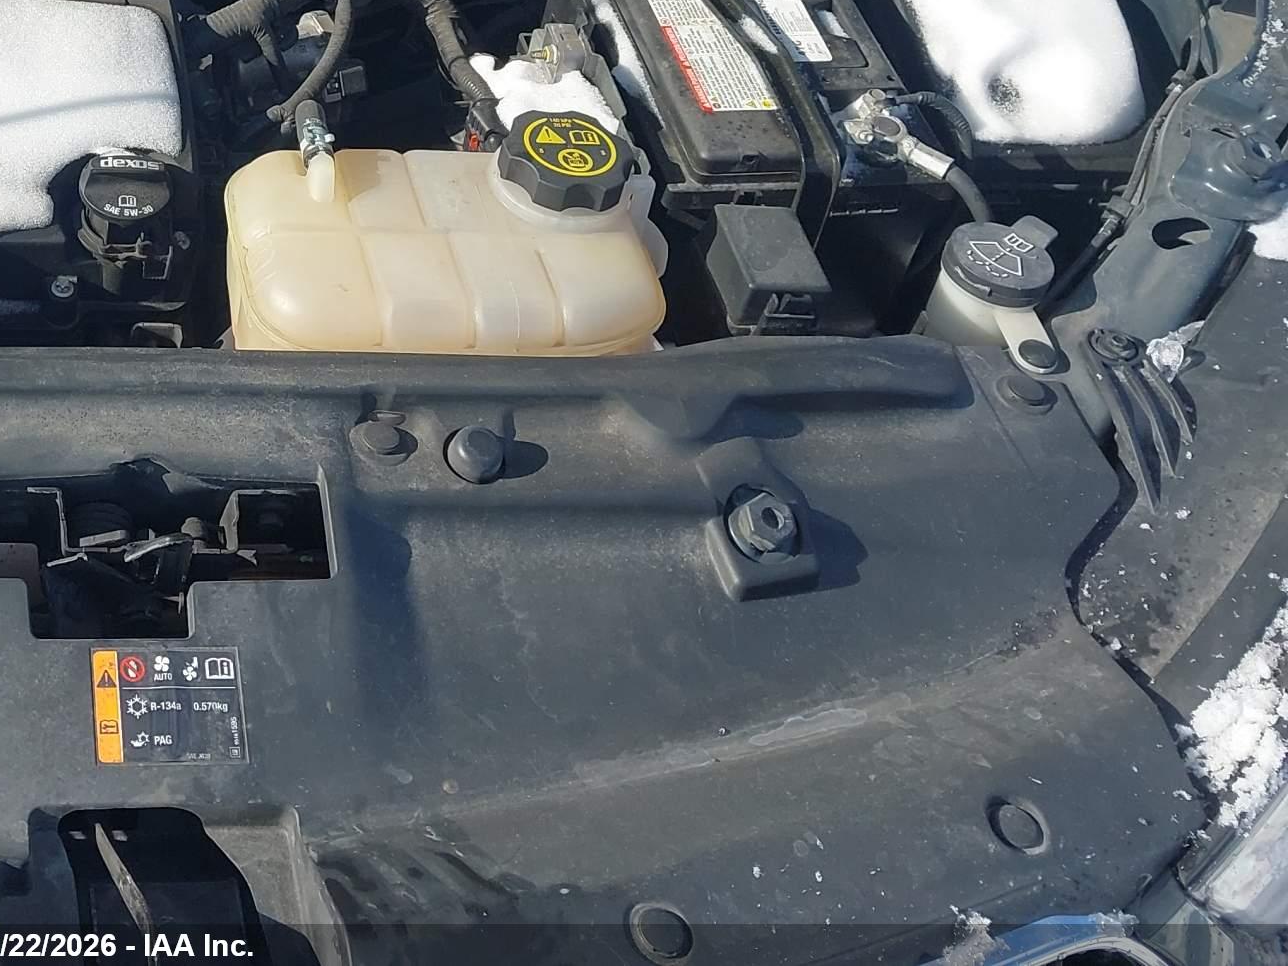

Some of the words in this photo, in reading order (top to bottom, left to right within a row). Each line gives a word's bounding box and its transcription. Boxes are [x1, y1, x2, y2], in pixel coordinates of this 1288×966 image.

[103, 203, 121, 215] SAE
[124, 204, 153, 216] 5W-30
[153, 673, 173, 681] AUTO
[150, 701, 182, 711] R-134a
[193, 701, 229, 713] 0.570kg
[154, 735, 173, 746] PAG
